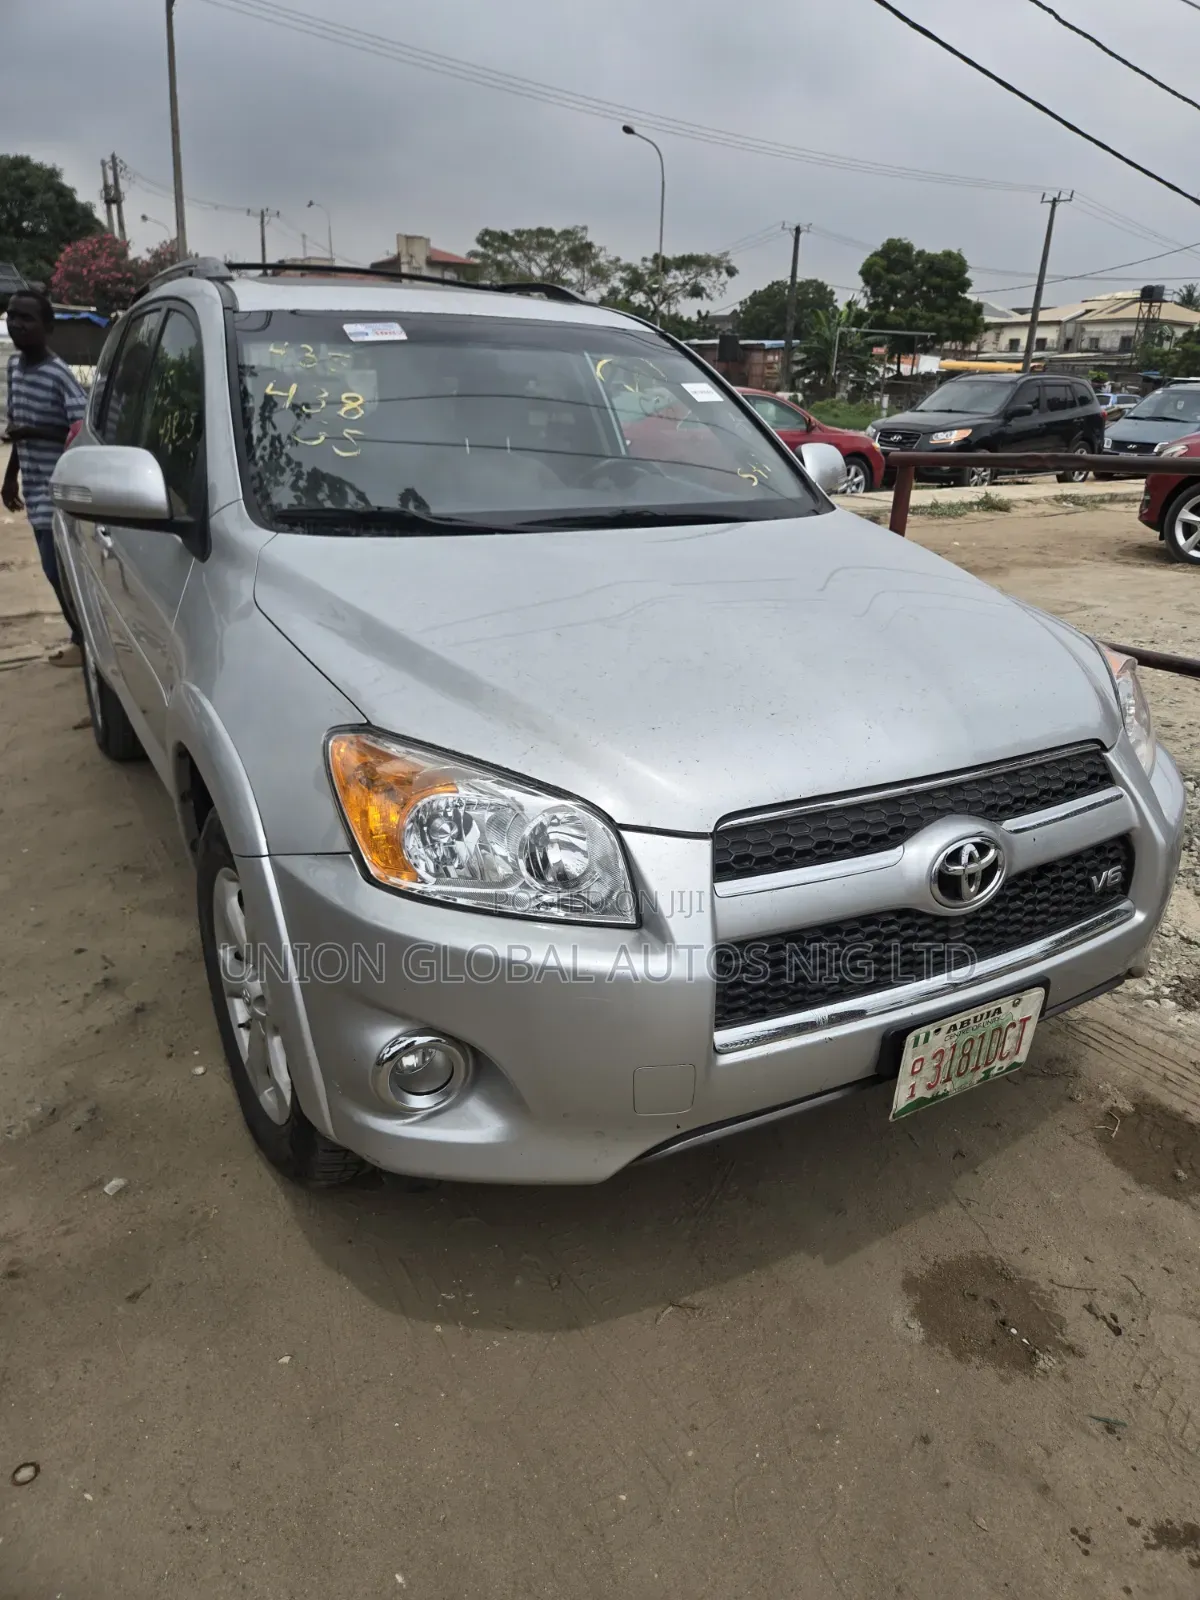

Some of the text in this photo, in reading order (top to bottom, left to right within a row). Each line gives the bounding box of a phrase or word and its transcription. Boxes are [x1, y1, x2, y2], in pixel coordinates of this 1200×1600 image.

[265, 381, 364, 420] 438
[1091, 865, 1122, 893] V6
[946, 1006, 1003, 1034] ABUJA
[926, 1015, 1032, 1090] 3181DCT
